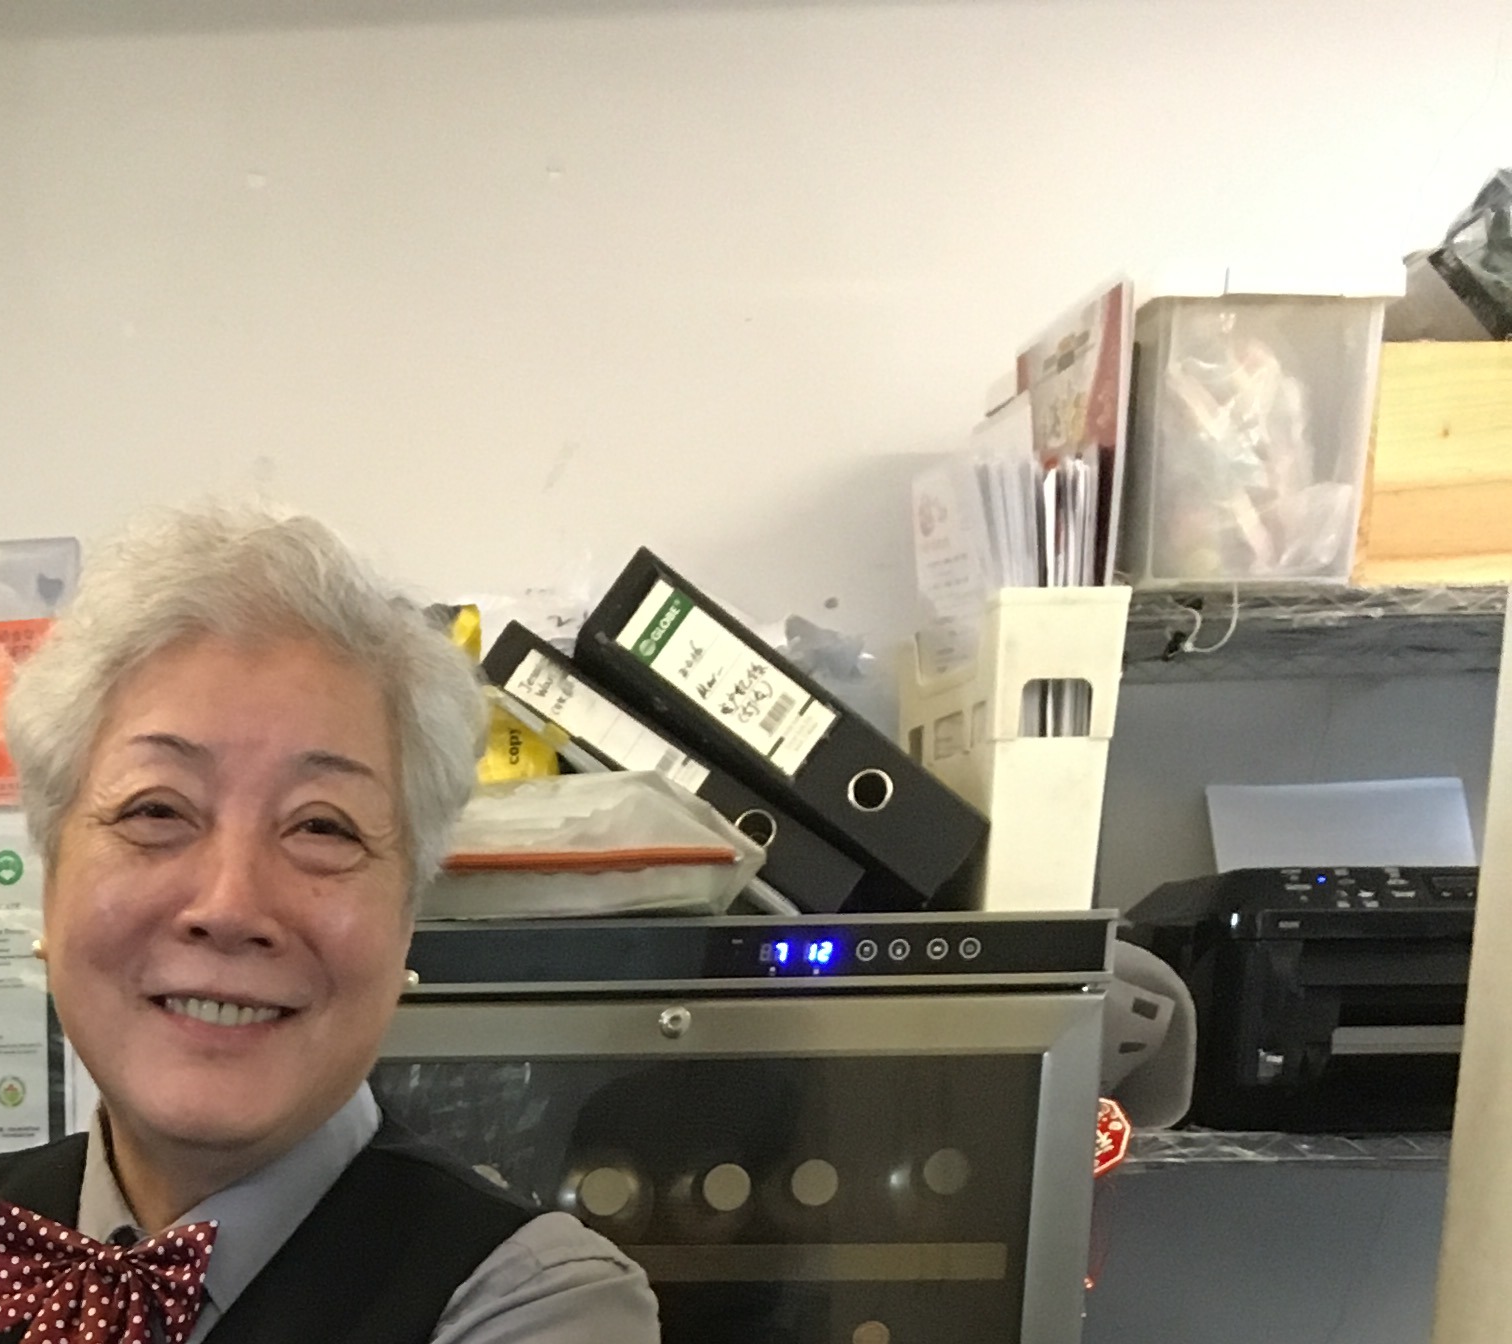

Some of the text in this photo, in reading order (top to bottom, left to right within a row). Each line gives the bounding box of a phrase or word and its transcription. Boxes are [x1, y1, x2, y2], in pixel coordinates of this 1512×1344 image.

[650, 606, 681, 642] GLOBE
[775, 940, 834, 964] 7 12
